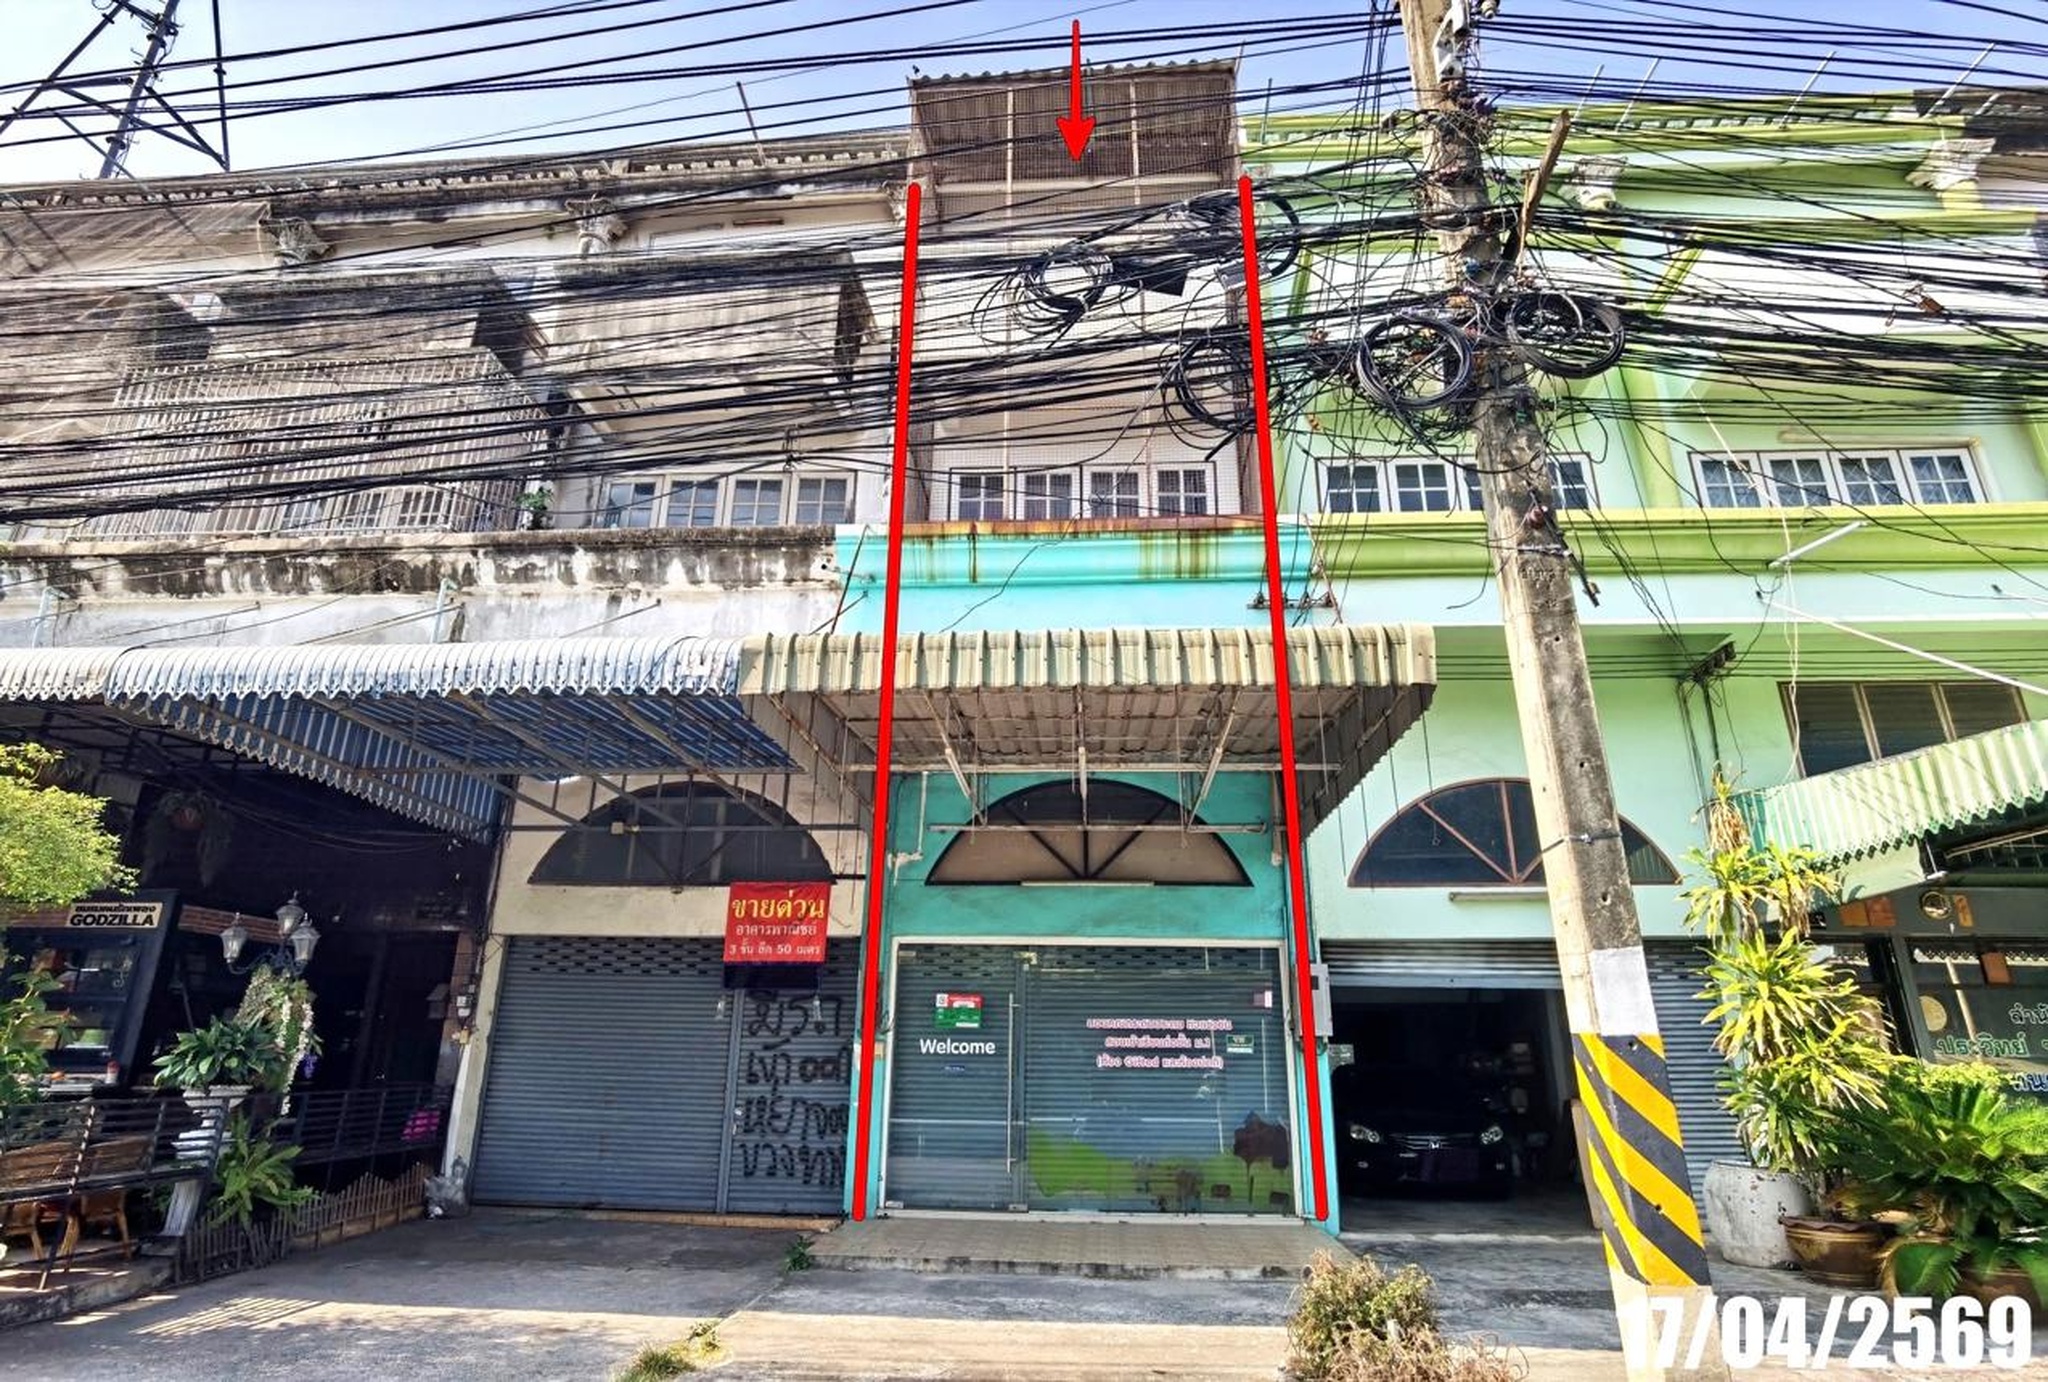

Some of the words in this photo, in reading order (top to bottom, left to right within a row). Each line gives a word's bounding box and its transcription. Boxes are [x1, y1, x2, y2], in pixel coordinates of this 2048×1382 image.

[732, 889, 825, 919] ขายด่วน
[70, 914, 155, 926] GODZILLA
[736, 920, 817, 936] อาคารพาณิชย์
[729, 944, 737, 954] 3
[740, 938, 754, 954] ชั้น
[777, 944, 792, 954] 50
[919, 1037, 996, 1054] Welcome
